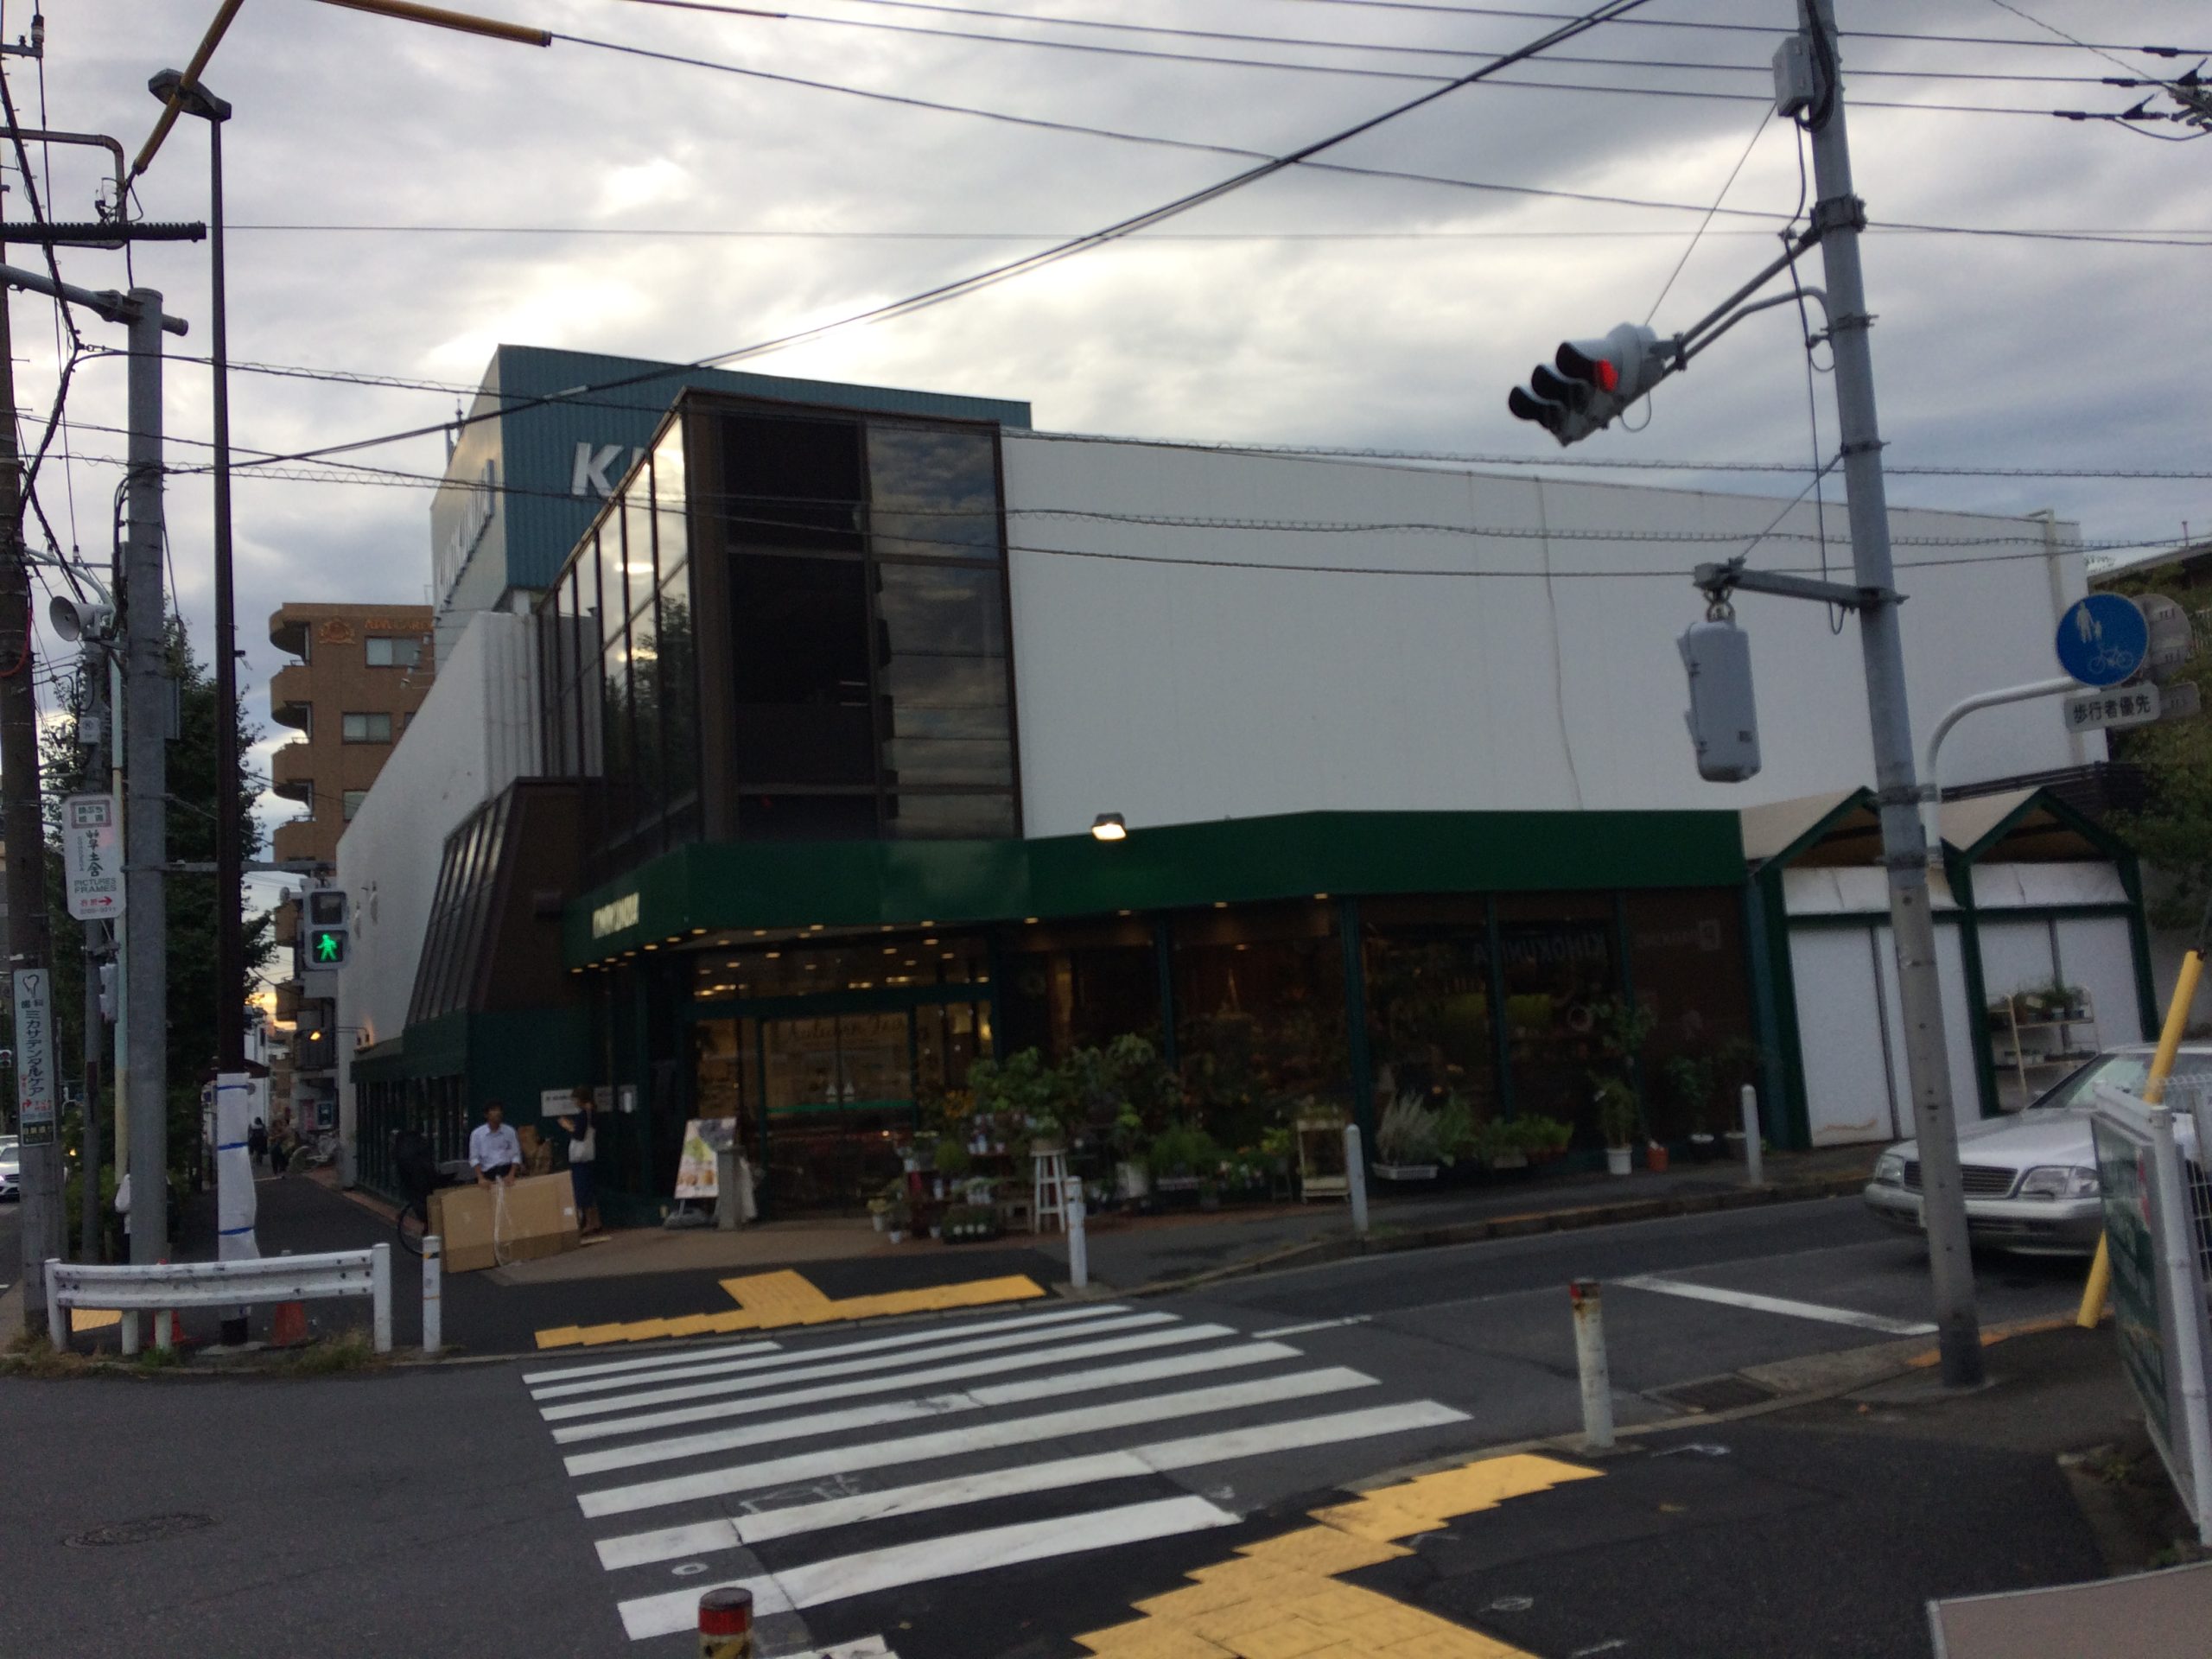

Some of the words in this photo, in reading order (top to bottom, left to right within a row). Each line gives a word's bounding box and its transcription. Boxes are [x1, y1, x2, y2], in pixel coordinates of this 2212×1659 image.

[2073, 694, 2152, 723] 歩行者優先
[73, 877, 117, 887] PICTURES
[74, 884, 117, 893] FRAMES
